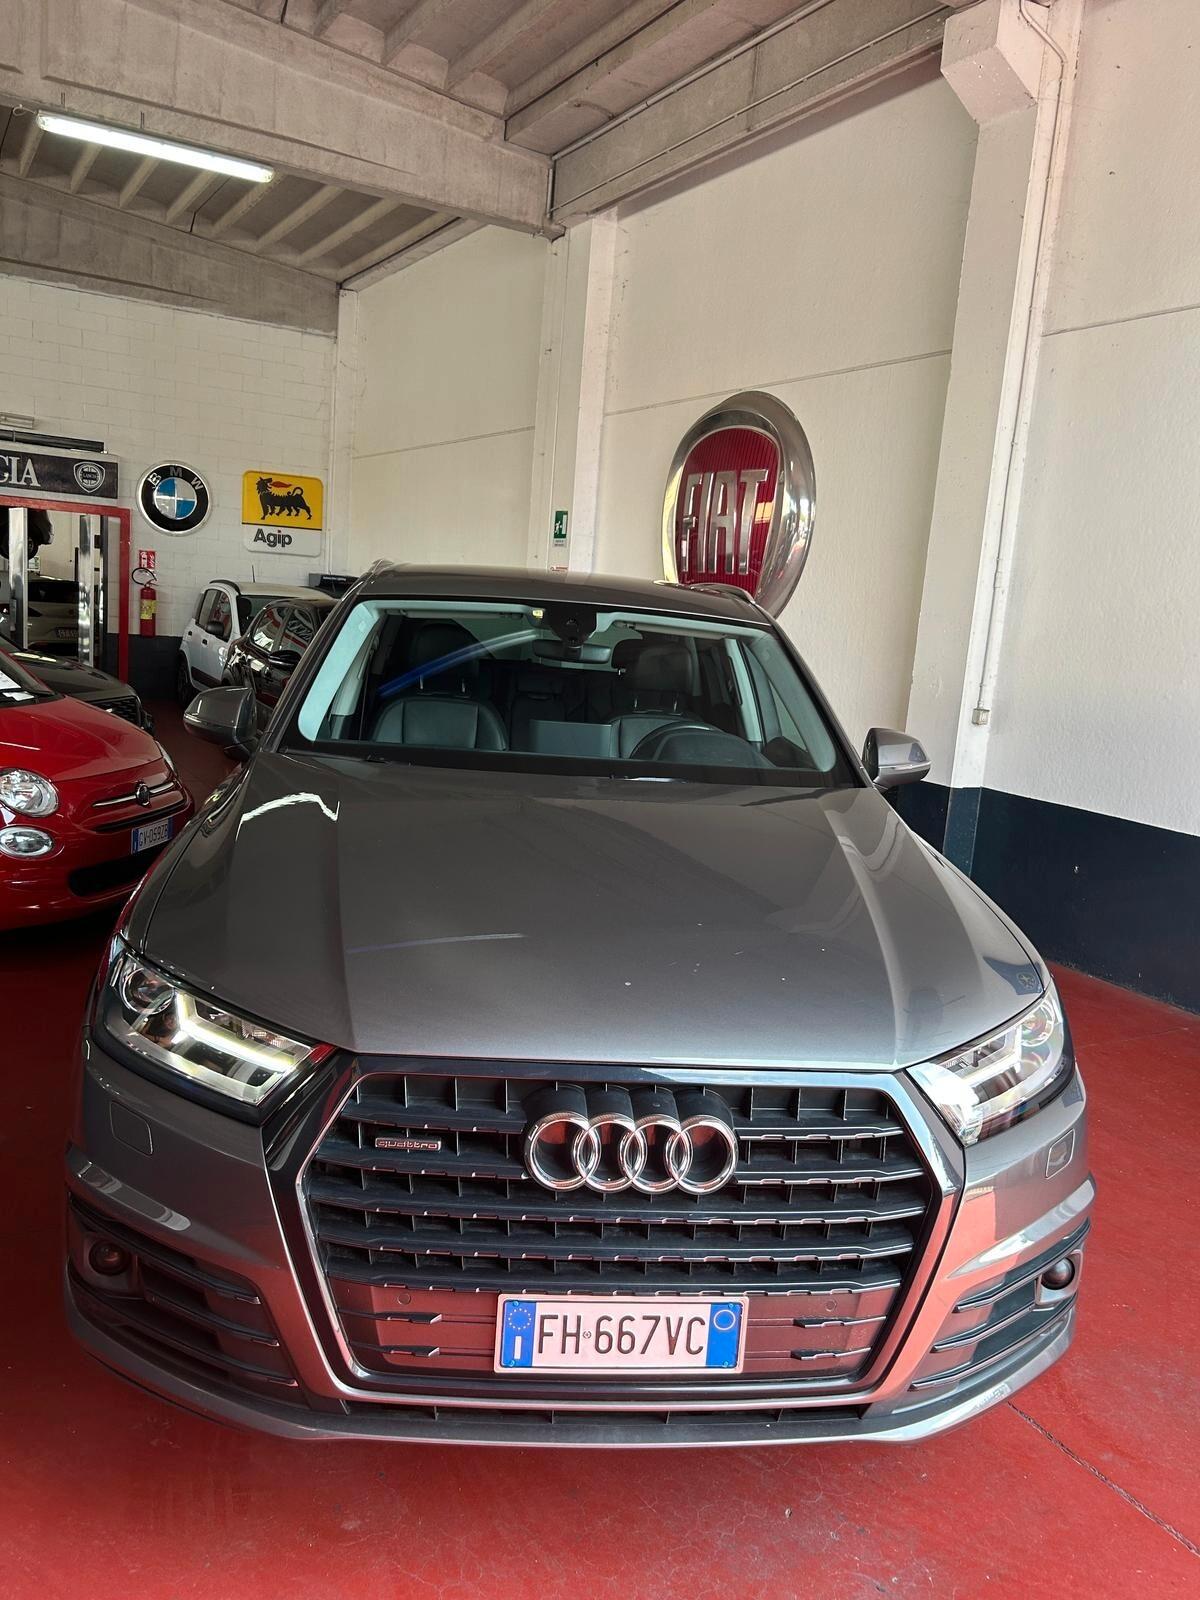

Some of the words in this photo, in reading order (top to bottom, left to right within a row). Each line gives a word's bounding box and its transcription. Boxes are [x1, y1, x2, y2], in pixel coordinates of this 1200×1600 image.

[147, 466, 204, 491] BMW
[681, 468, 769, 575] FIAT
[253, 528, 293, 548] Agip
[377, 1140, 438, 1150] quattro
